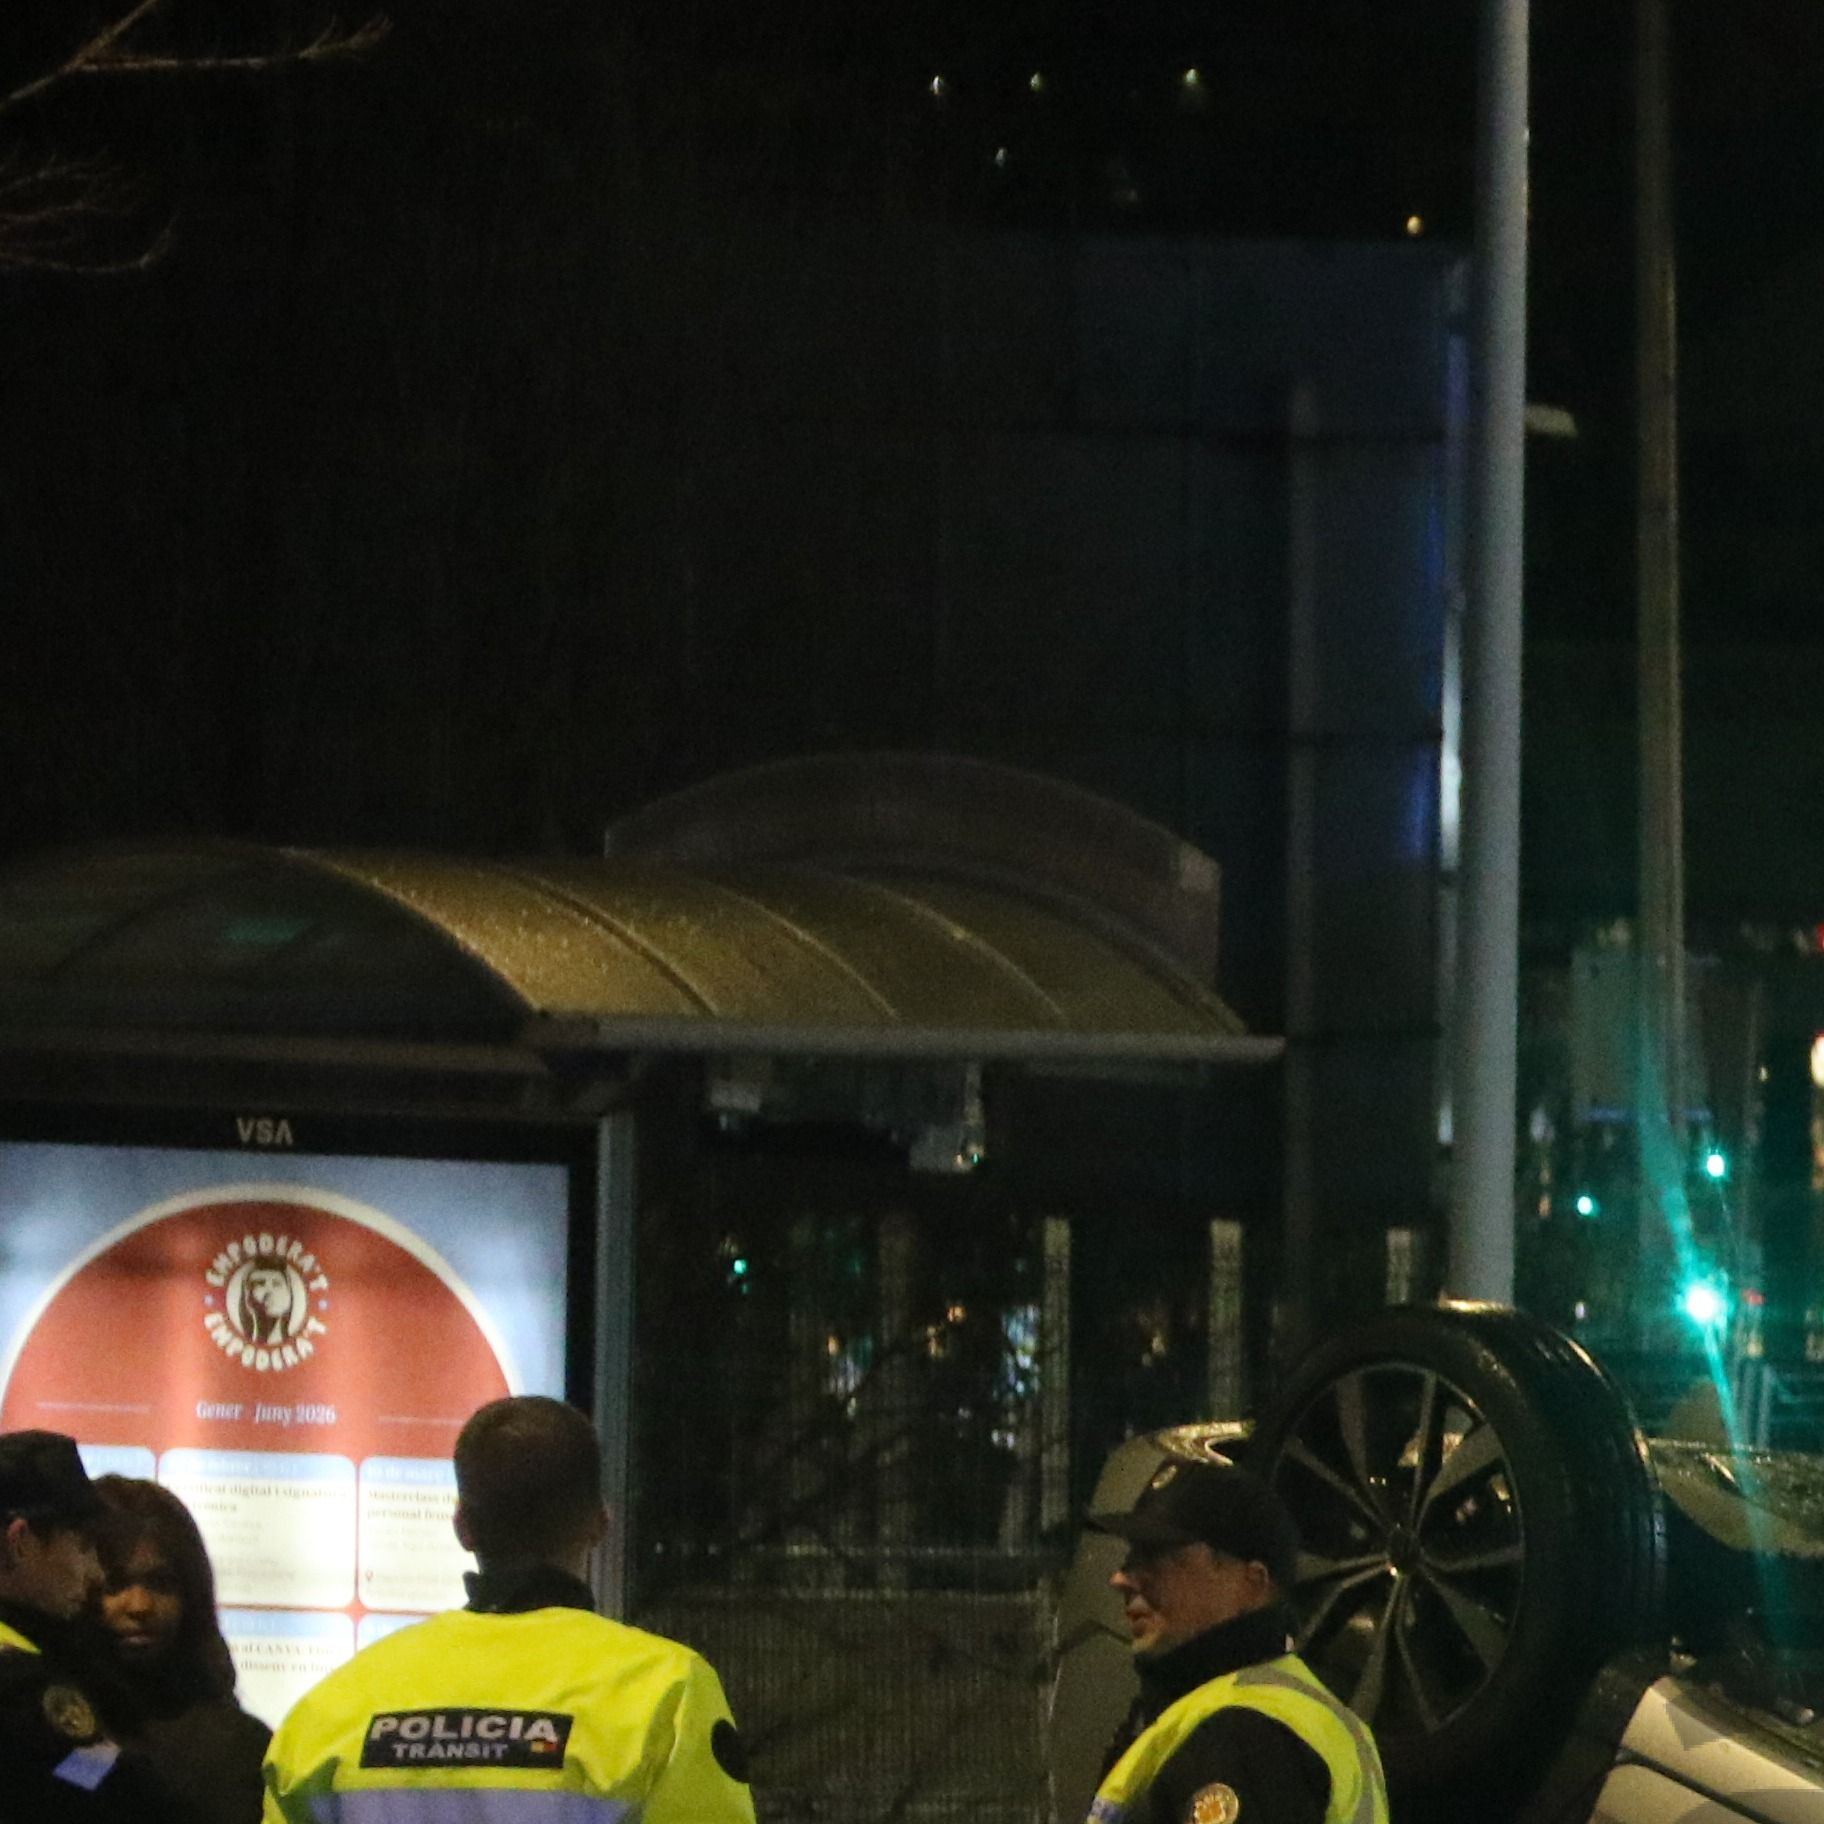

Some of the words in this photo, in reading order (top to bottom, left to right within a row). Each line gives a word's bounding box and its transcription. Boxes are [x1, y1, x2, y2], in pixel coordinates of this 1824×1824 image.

[237, 1117, 294, 1145] VSA
[195, 1401, 243, 1420] Gener
[255, 1402, 293, 1427] Juny
[295, 1403, 337, 1424] 2026
[370, 1715, 559, 1742] POLICIA
